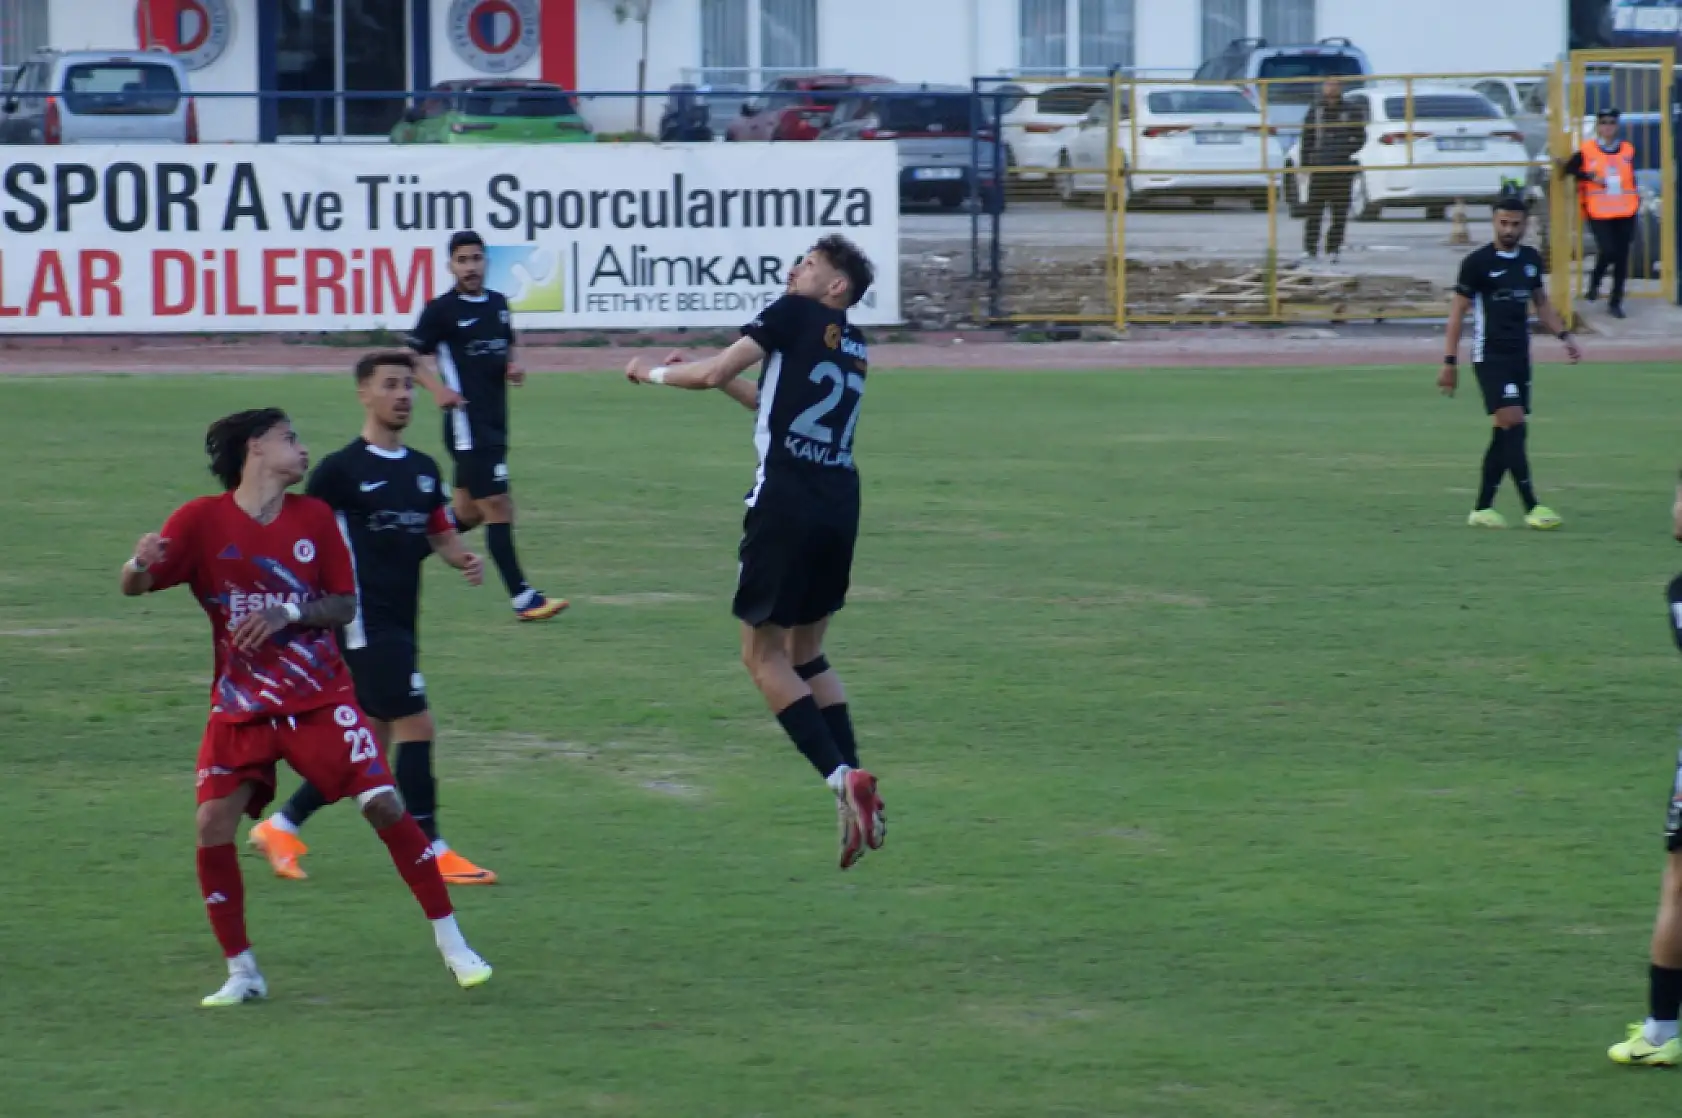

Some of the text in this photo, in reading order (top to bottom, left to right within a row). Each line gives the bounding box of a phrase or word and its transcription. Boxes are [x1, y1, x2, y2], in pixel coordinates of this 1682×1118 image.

[283, 192, 343, 231] ve
[356, 175, 473, 230] Tüm
[487, 173, 872, 241] Sporcularımıza
[789, 361, 864, 448] 27
[343, 726, 378, 763] 23
